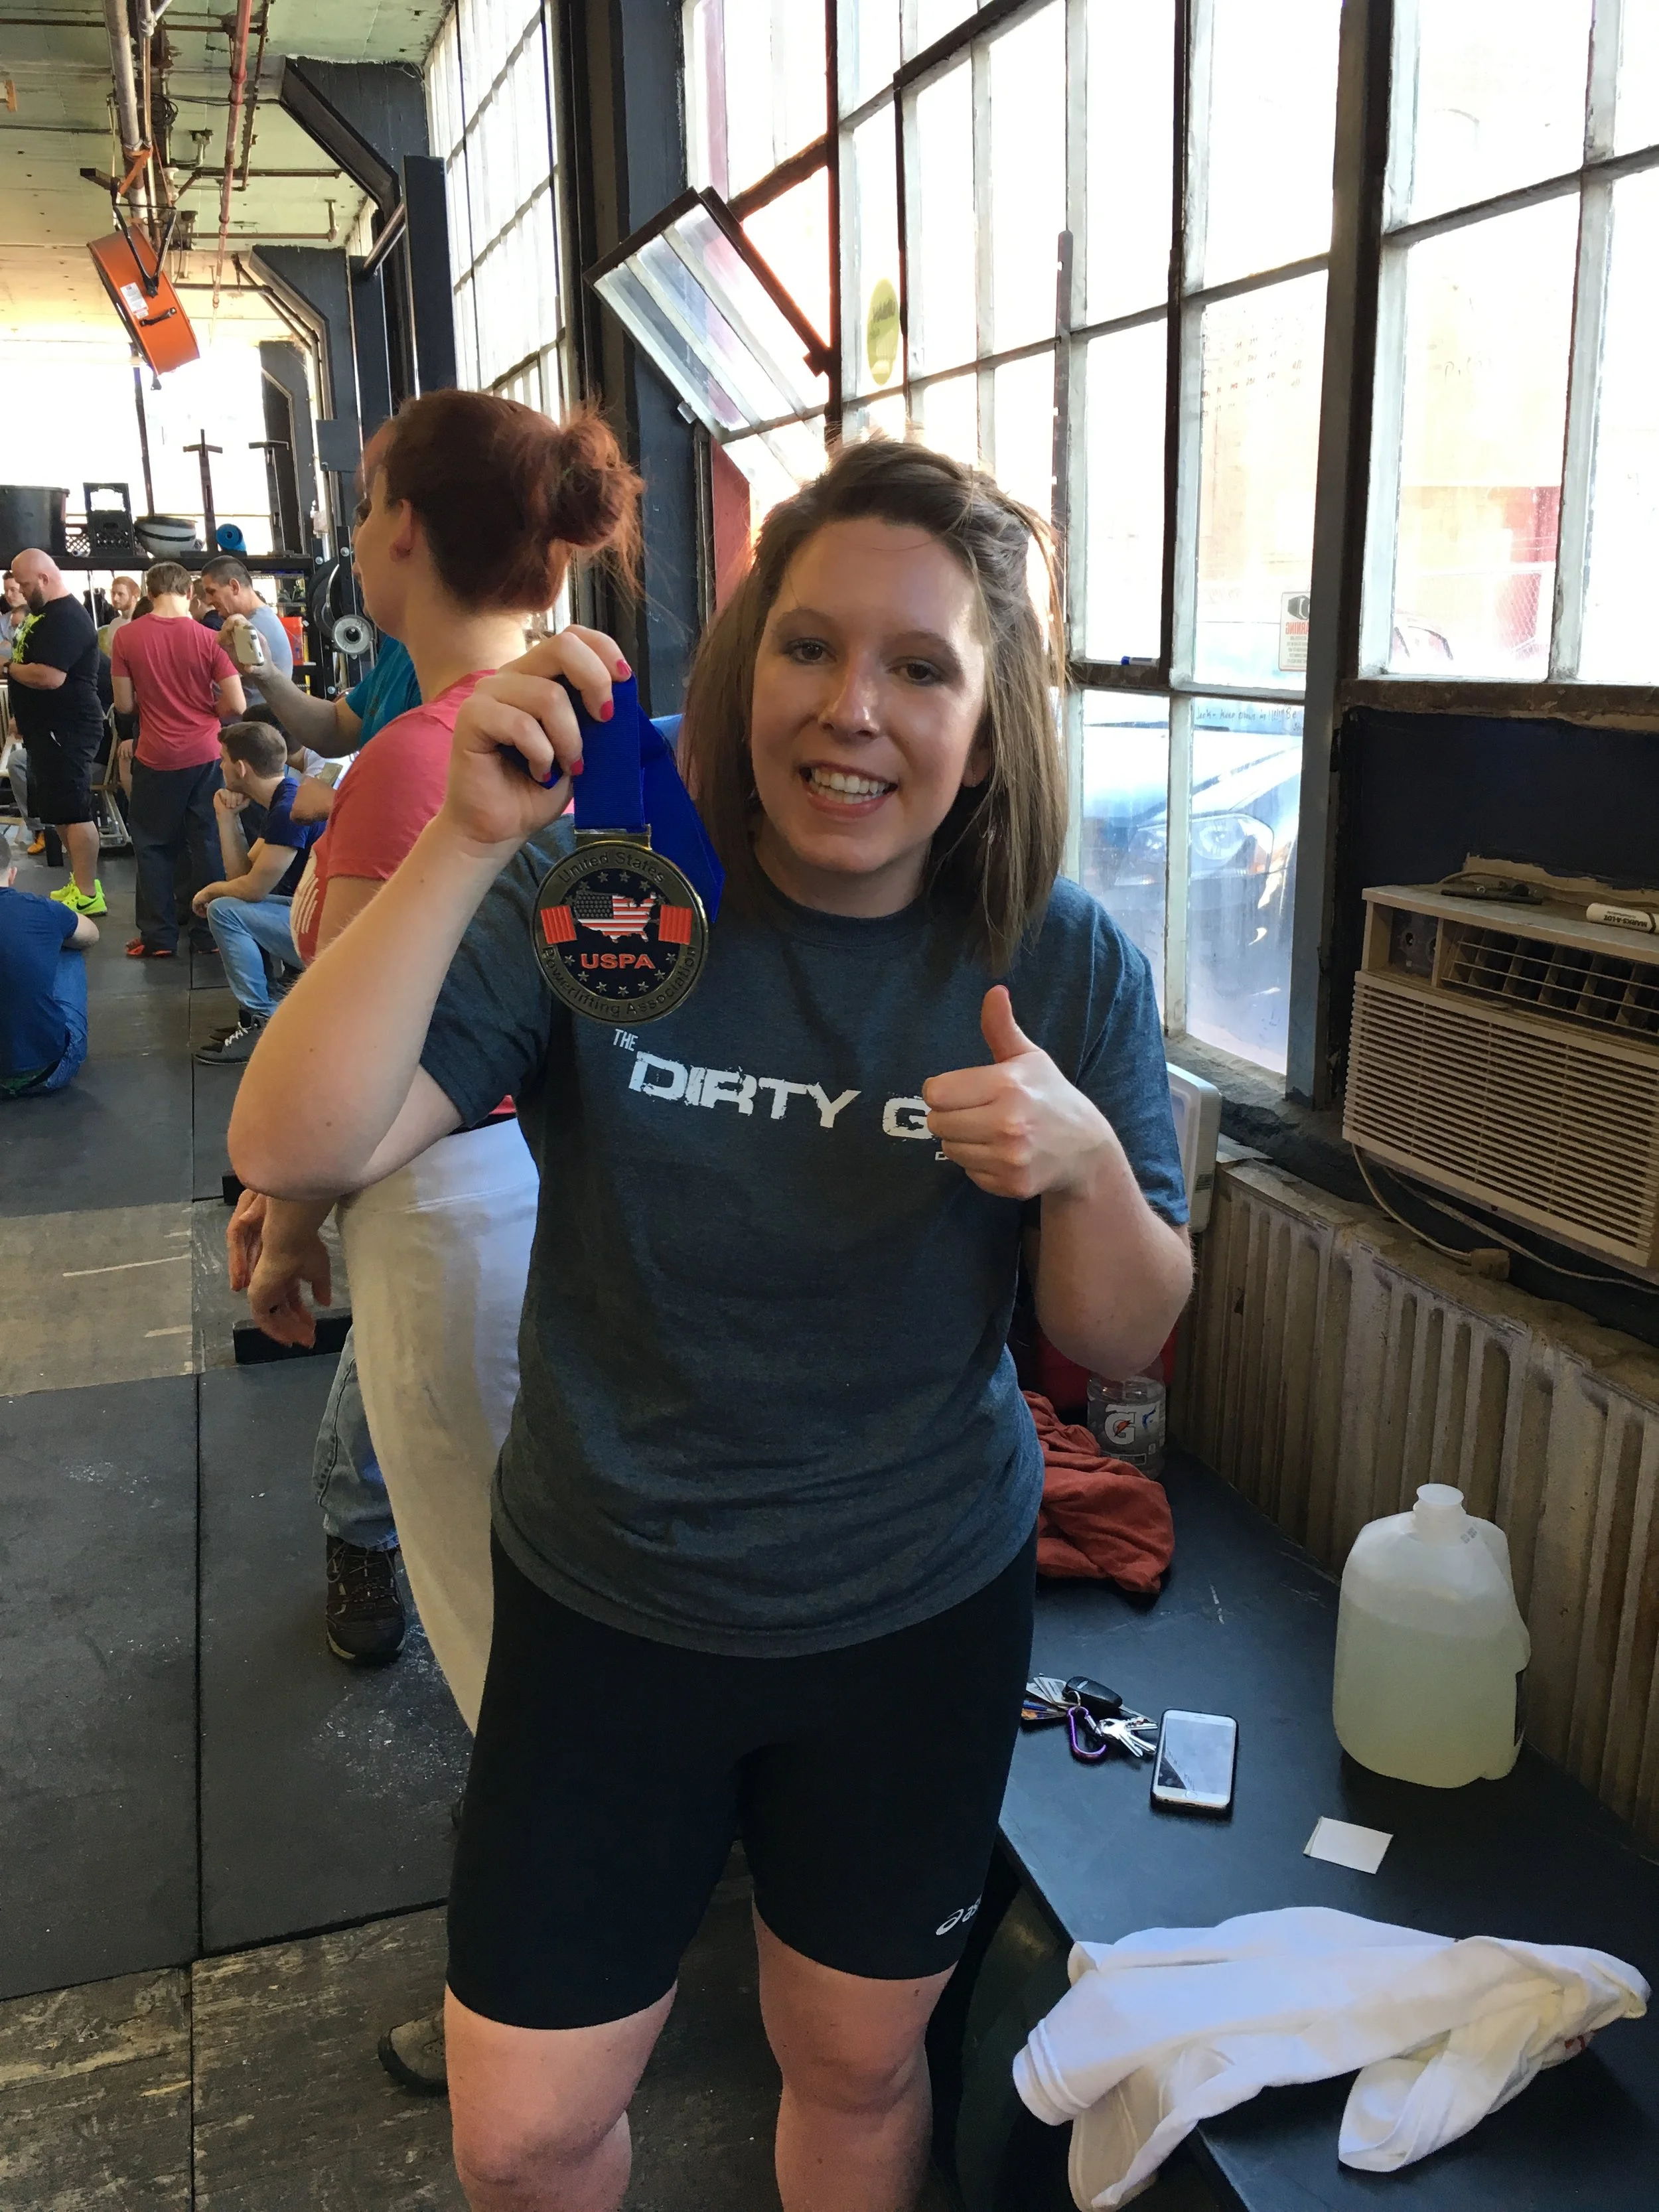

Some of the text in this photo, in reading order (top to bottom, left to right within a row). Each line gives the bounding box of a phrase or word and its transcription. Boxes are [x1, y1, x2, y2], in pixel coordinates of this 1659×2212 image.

[558, 851, 664, 884] United States
[580, 953, 655, 969] USPA
[541, 946, 696, 1017] Powerlifting Association
[613, 1029, 638, 1051] THE
[628, 1051, 862, 1128] DIRTY
[1105, 1412, 1136, 1445] G
